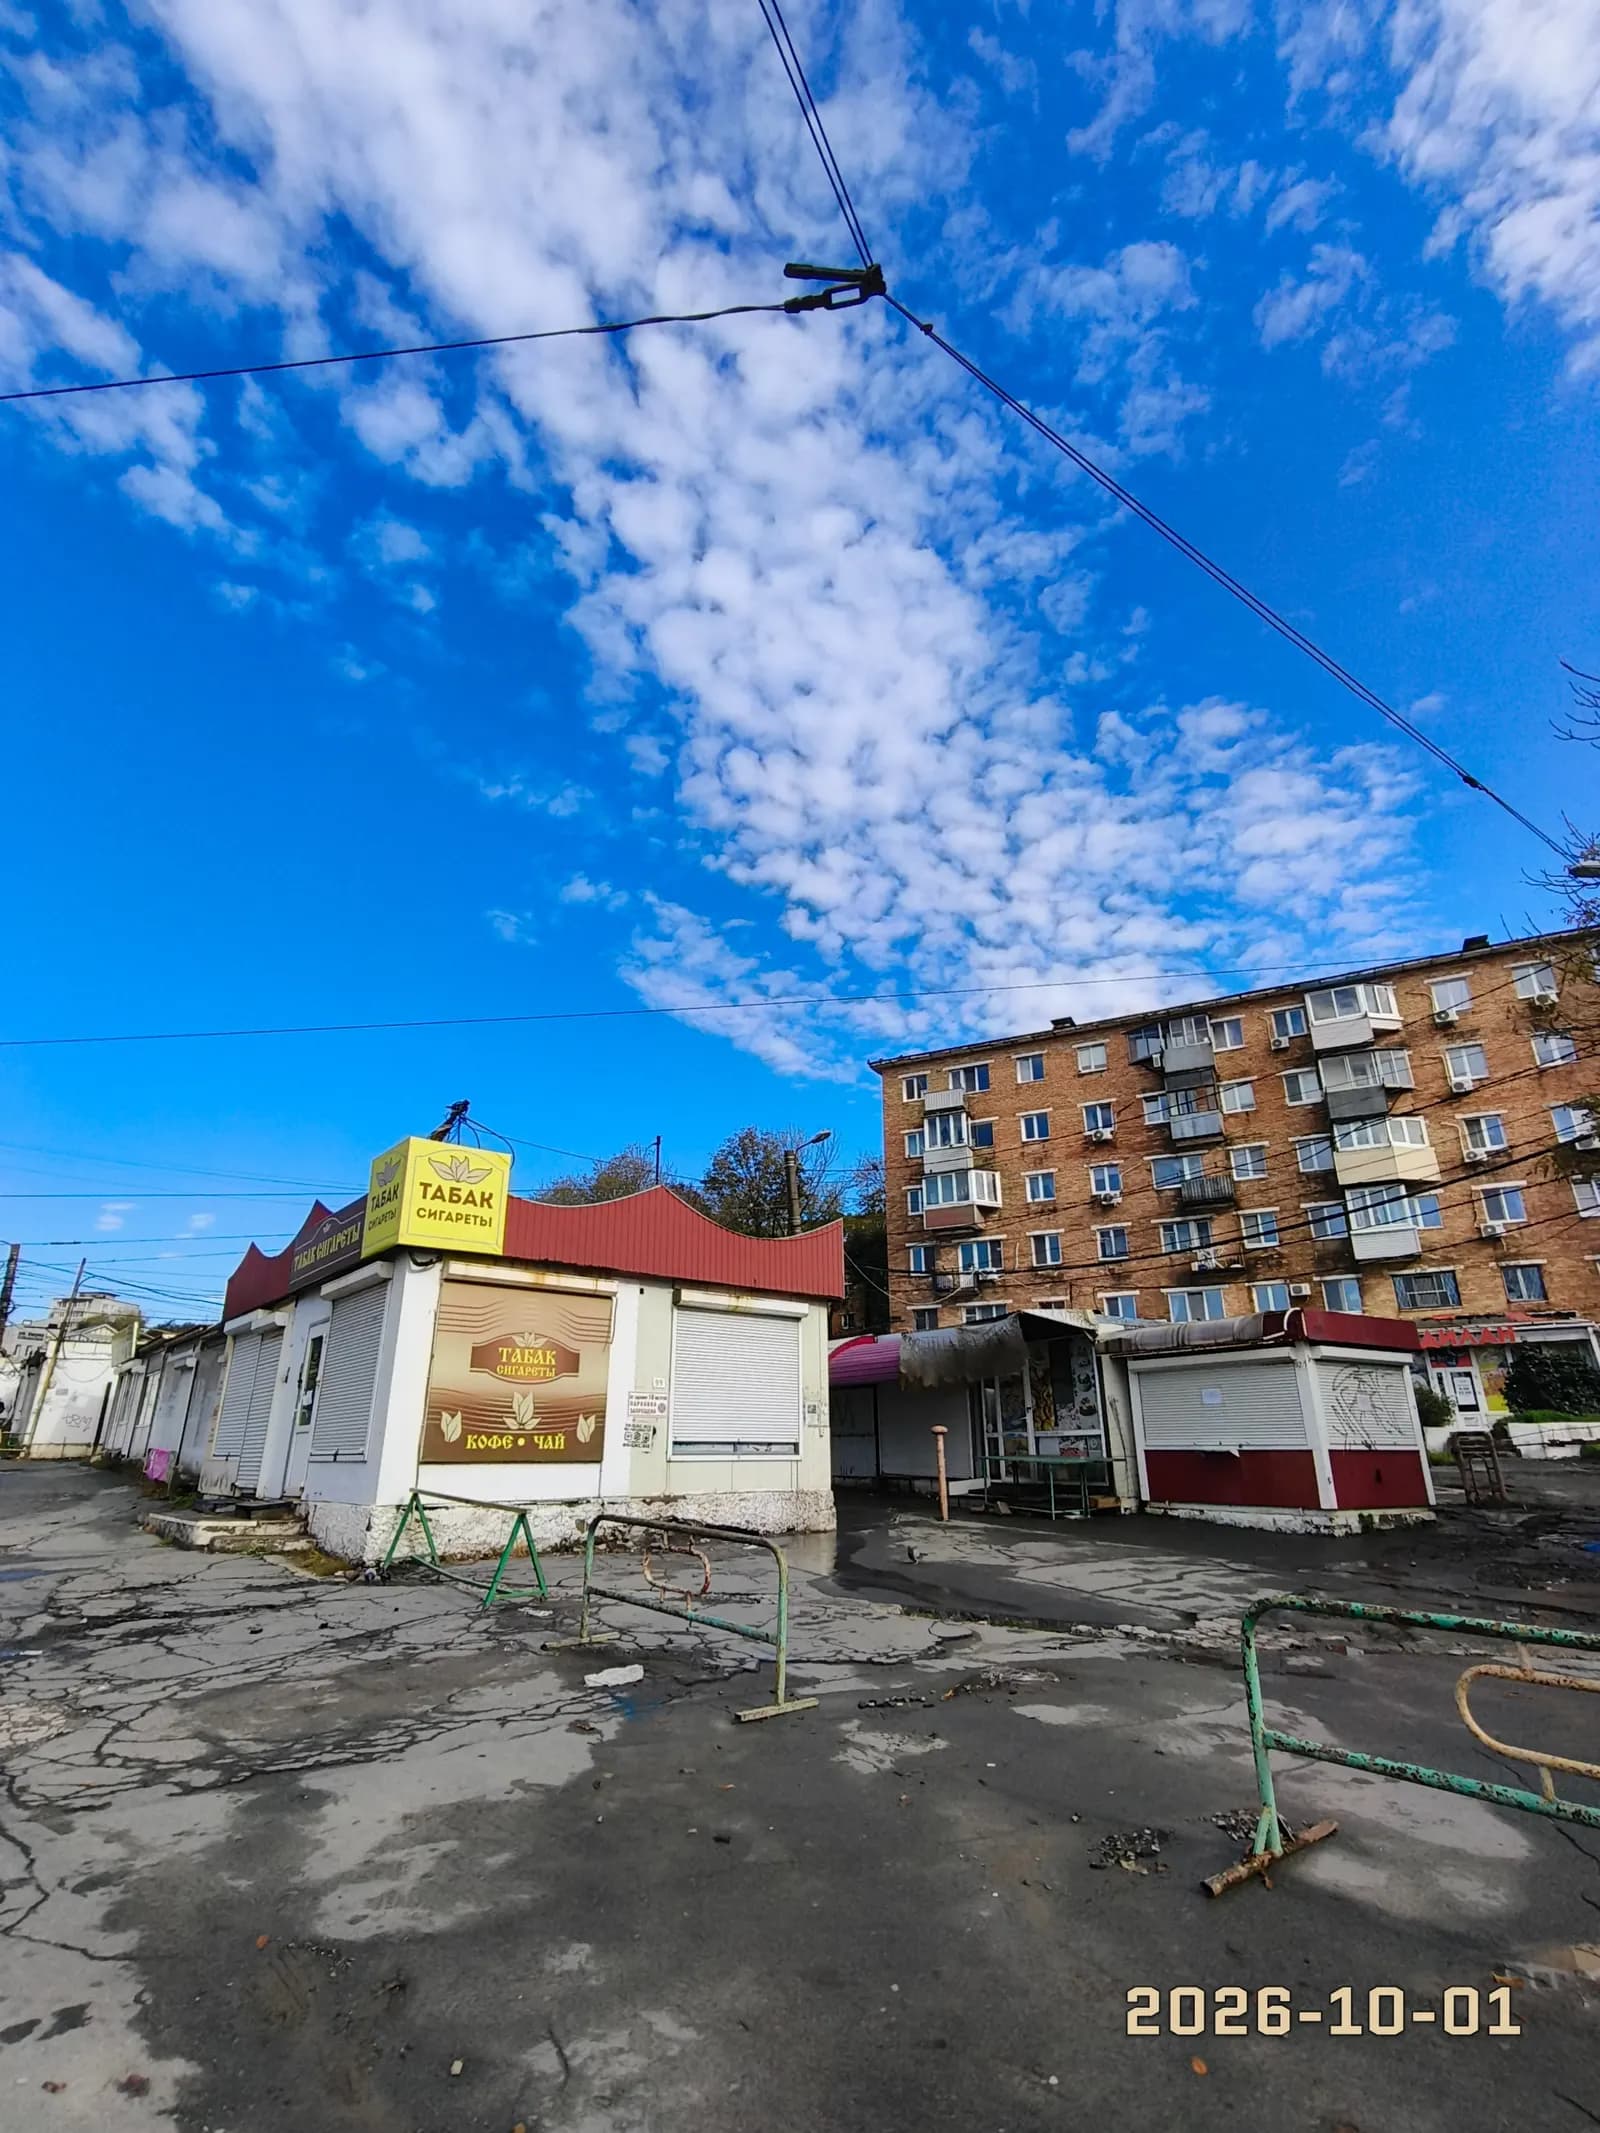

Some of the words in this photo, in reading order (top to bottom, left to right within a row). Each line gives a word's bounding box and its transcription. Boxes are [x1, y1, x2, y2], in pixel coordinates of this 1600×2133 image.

[371, 1182, 400, 1213] ТАБАК
[419, 1181, 494, 1209] ТАБАК
[367, 1208, 397, 1232] СИГАРЕТЫ
[416, 1207, 493, 1228] СИГАРЕТЫ
[498, 1347, 556, 1366] ТАБАК
[496, 1364, 556, 1377] СИГАРЕТЫ
[465, 1433, 514, 1450] КОФЕ
[533, 1432, 566, 1450] ЧАЙ
